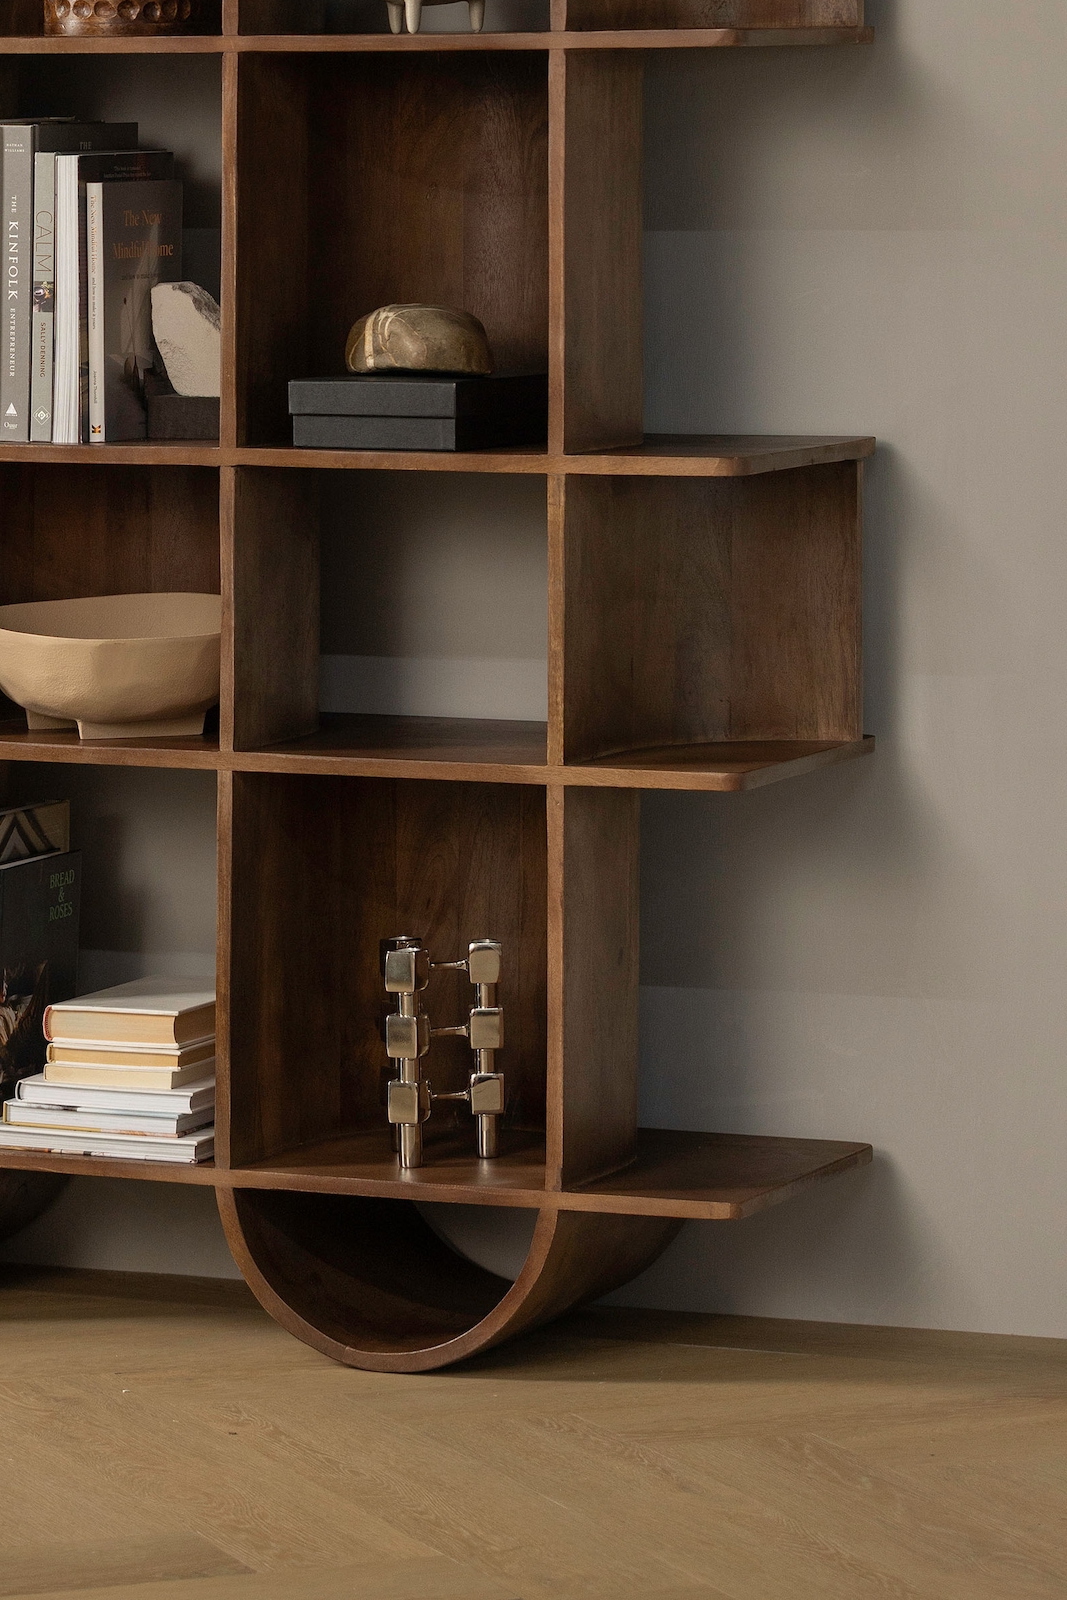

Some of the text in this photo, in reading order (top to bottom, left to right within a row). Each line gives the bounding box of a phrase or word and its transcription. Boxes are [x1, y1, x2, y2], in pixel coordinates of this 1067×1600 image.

[79, 141, 92, 150] THE
[123, 210, 162, 227] The New
[35, 210, 52, 273] CALM
[112, 240, 145, 259] Mindful
[8, 221, 19, 300] KINFOLK
[49, 869, 75, 889] BREAD
[58, 887, 65, 903] &
[48, 902, 73, 922] ROSES
